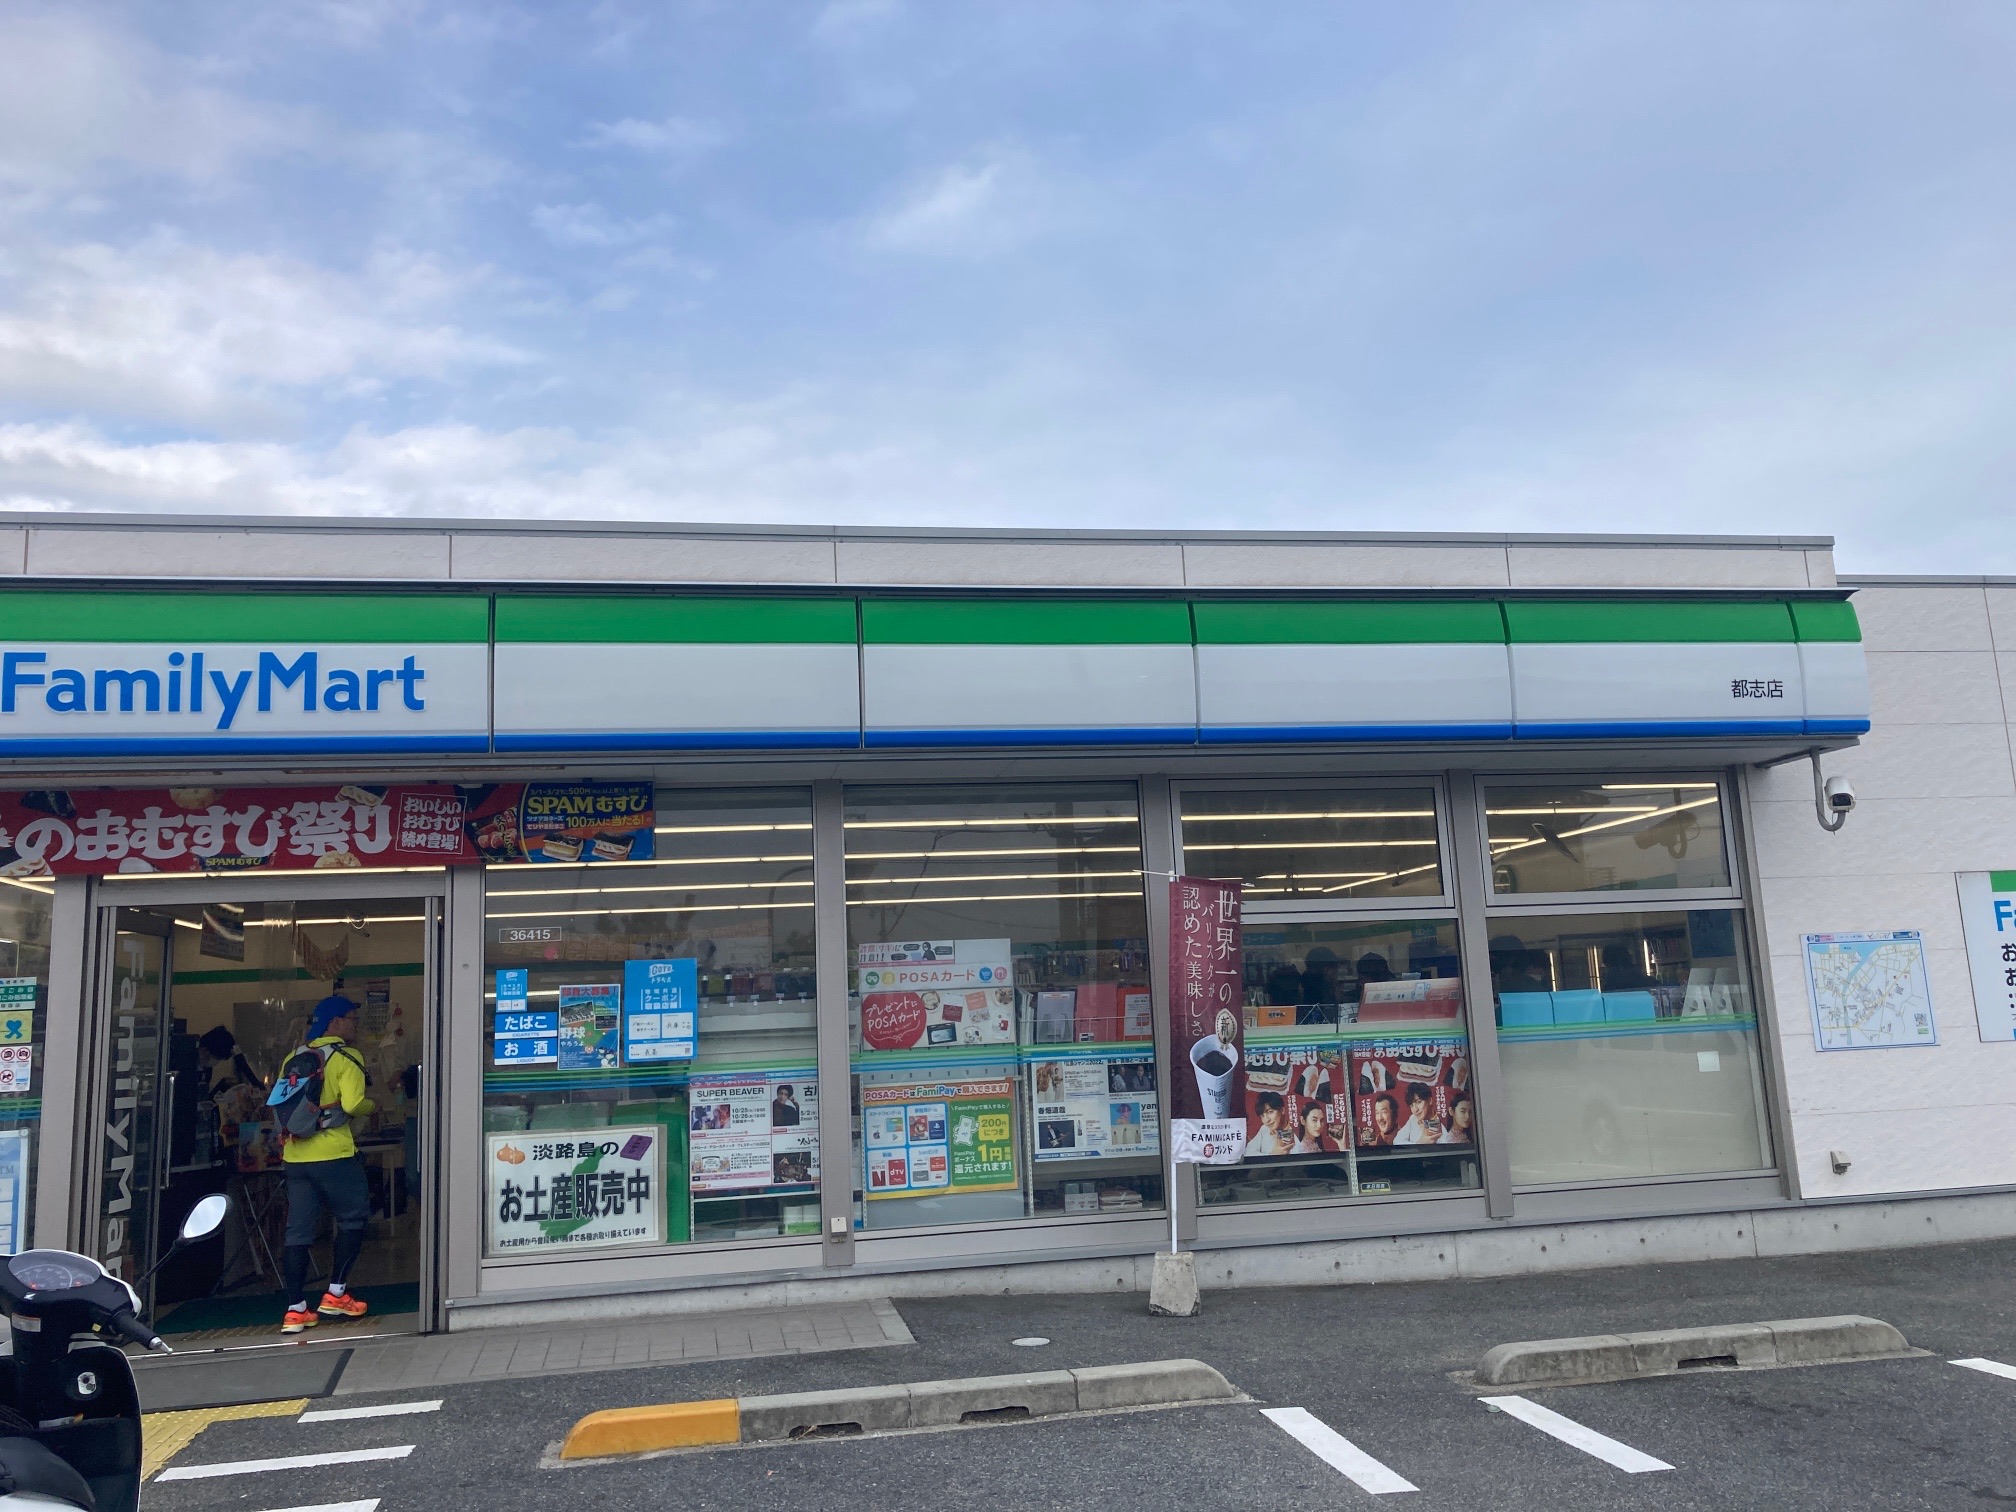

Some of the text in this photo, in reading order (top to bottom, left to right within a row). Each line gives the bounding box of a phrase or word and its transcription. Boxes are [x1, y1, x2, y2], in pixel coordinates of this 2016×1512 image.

[2, 651, 425, 730] FamilyMart
[1731, 679, 1784, 699] 都志店
[404, 797, 461, 814] おいしい
[0, 800, 392, 863] のおむすび祭り
[403, 814, 461, 831] おむすび
[1993, 900, 2016, 932] F
[510, 929, 551, 940] 36415
[1202, 904, 1215, 998] バリスタが
[1215, 889, 1238, 1005] 世界一の
[899, 969, 976, 983] POSAカード
[505, 1016, 547, 1031] たばこ
[868, 1010, 921, 1032] POSAカード
[696, 1087, 765, 1098] SUPER BEAVER
[106, 940, 146, 1279] FamilyMar
[984, 1128, 1004, 1136] につき
[533, 1142, 619, 1161] 淡路島の
[954, 1162, 1012, 1174] 還元されます!
[500, 1168, 651, 1223] お土産販売中
